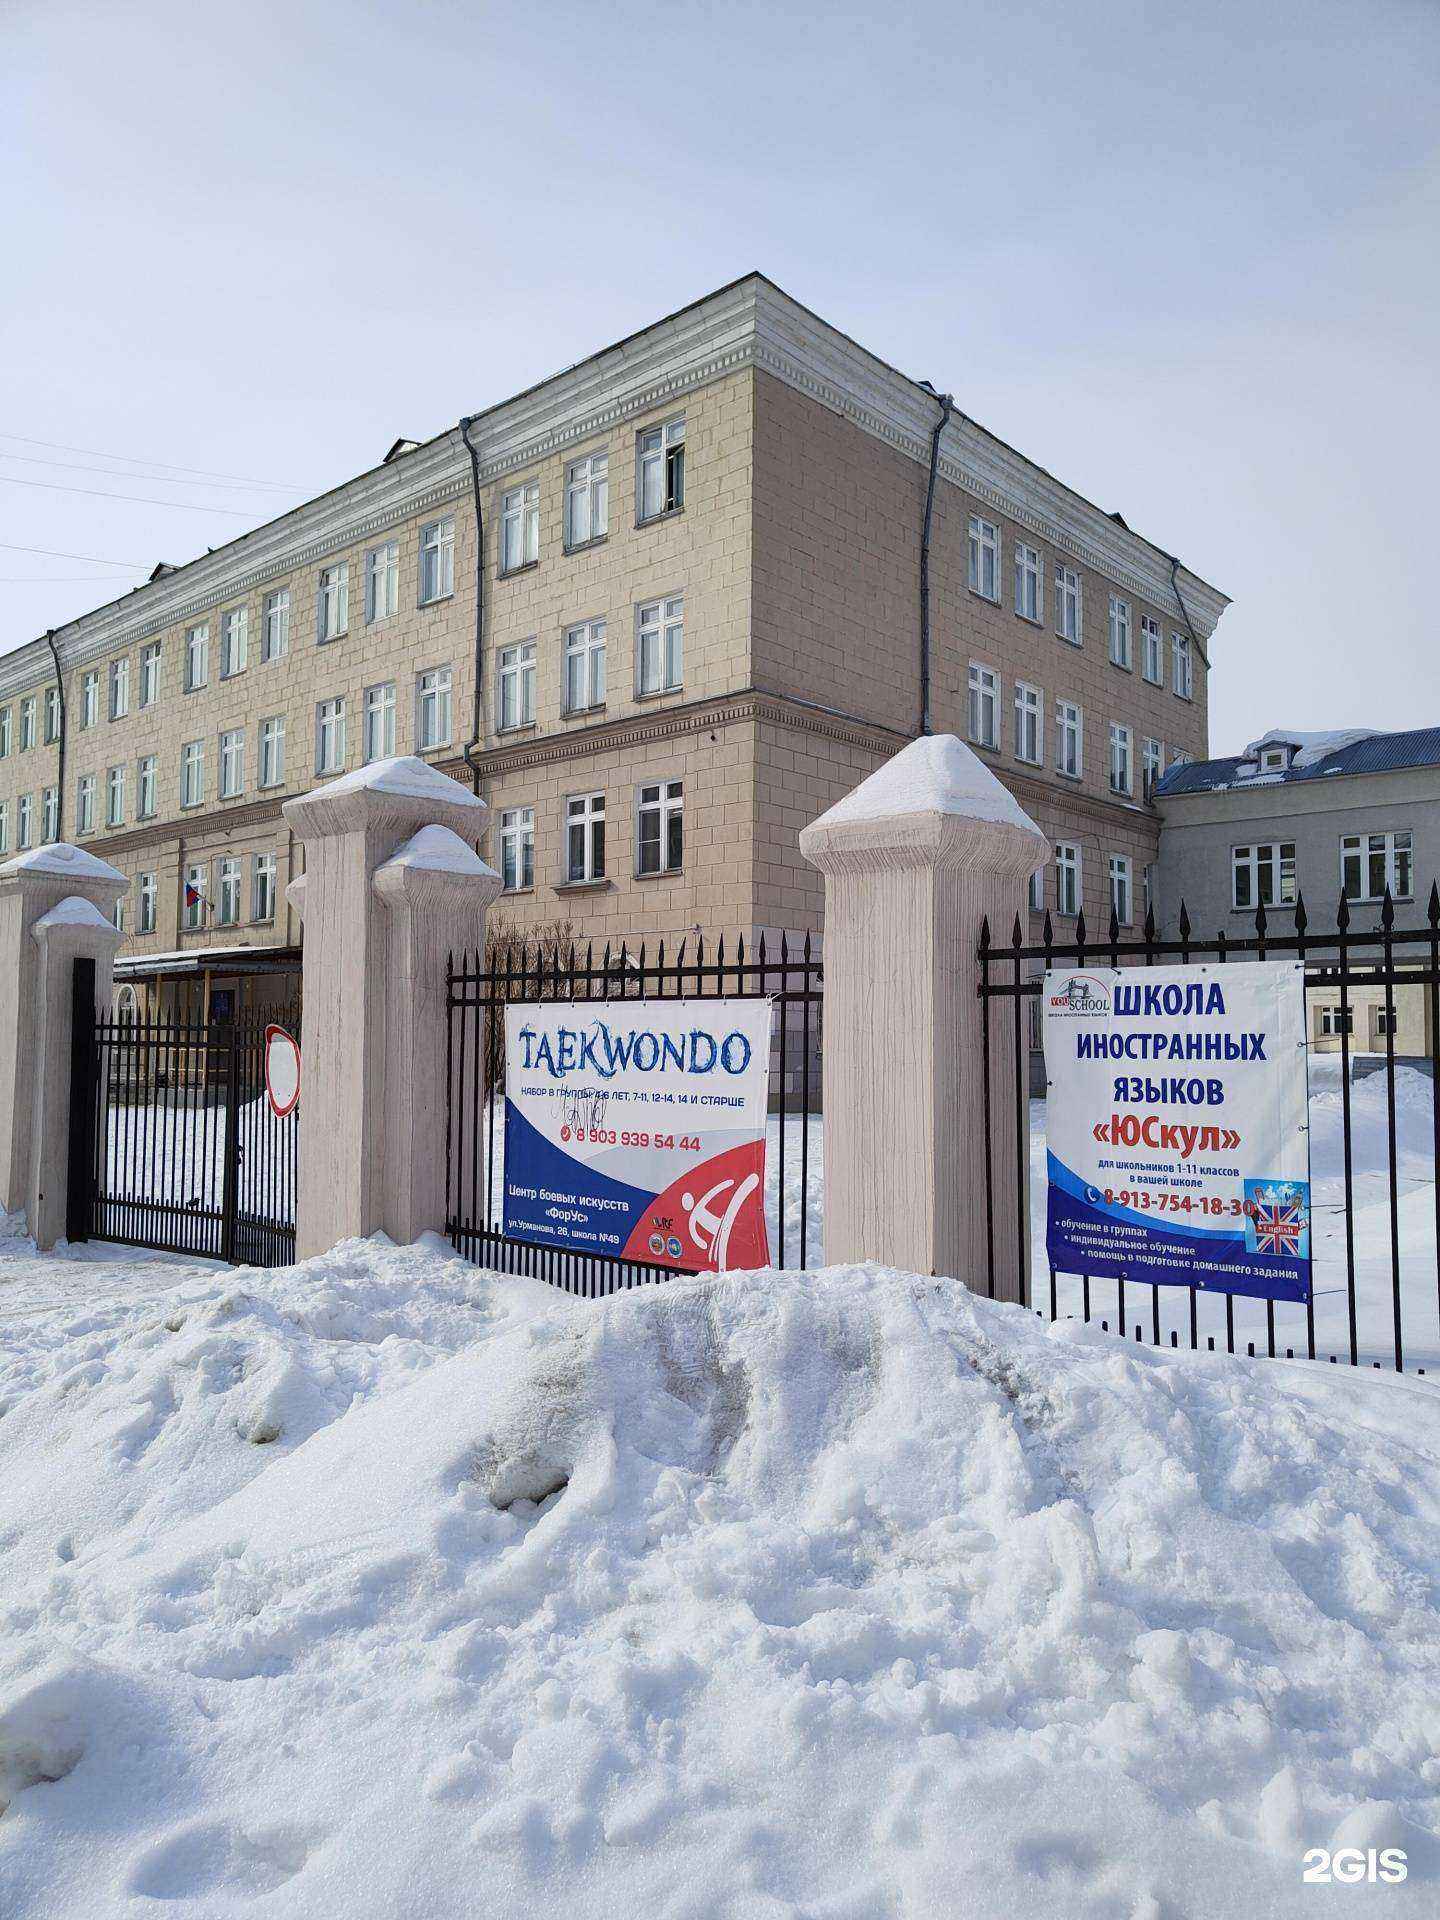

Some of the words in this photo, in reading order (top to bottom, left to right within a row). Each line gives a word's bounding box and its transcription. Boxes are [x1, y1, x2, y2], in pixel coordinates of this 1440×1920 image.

[1113, 982, 1226, 1016] ШКОЛА
[518, 1018, 752, 1079] TAEKWONDO
[1076, 1033, 1267, 1061] ИНОСТРАННЫХ
[521, 1086, 547, 1097] НАБОР
[548, 1088, 555, 1097] В
[611, 1091, 631, 1102] ЛЕТ,
[633, 1092, 649, 1103] 7-11,
[652, 1093, 676, 1105] 12-14,
[678, 1094, 688, 1104] 14
[690, 1095, 698, 1105] И
[700, 1095, 745, 1107] СТАРШЕ
[1113, 1077, 1225, 1106] ЯЗЫКОВ
[576, 1128, 585, 1142] 8
[589, 1129, 617, 1144] 903
[621, 1131, 649, 1147] 939
[654, 1133, 675, 1149] 54
[679, 1136, 701, 1152] 44
[1092, 1114, 1242, 1160] «ЮСкул»
[1098, 1160, 1115, 1170] для
[1116, 1162, 1175, 1174] школьников
[1176, 1163, 1197, 1174] 1-11
[1200, 1166, 1240, 1177] классов
[1129, 1175, 1135, 1183] в
[1137, 1175, 1168, 1186] вашей
[1170, 1178, 1203, 1188] школе
[509, 1184, 537, 1201] Центр
[539, 1188, 577, 1205] боевых
[579, 1196, 630, 1212] искусств
[1104, 1188, 1255, 1217] 8-913-754-18-30
[545, 1206, 589, 1224] «ФорУс»
[1061, 1218, 1101, 1233] обучение
[1103, 1224, 1109, 1233] в
[1110, 1226, 1148, 1238] группах
[571, 1230, 597, 1241] школа
[599, 1232, 620, 1245] №49
[1070, 1233, 1148, 1251] индивидуальное
[1149, 1243, 1196, 1256] обучение
[1087, 1249, 1126, 1262] помощь
[1127, 1253, 1134, 1262] в
[1136, 1254, 1191, 1269] подготовке
[1192, 1260, 1252, 1275] домашнего
[1252, 1266, 1299, 1280] задания
